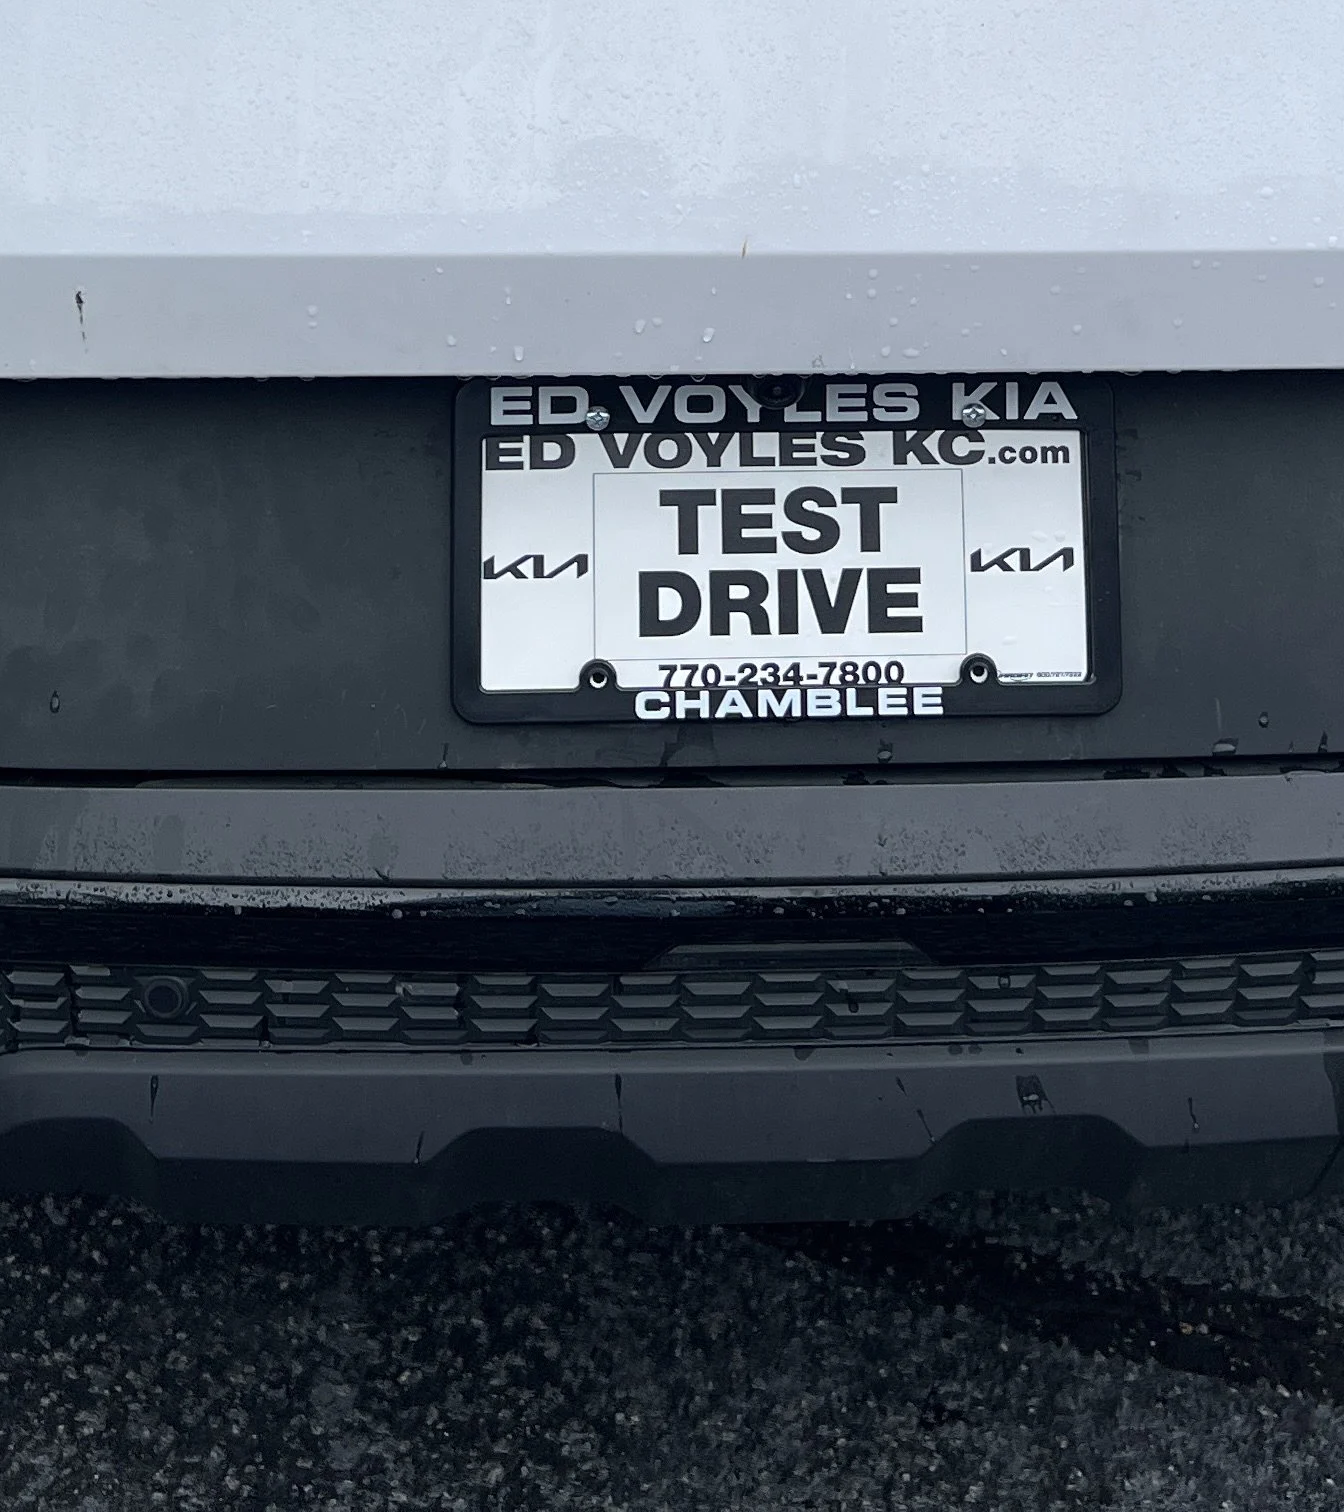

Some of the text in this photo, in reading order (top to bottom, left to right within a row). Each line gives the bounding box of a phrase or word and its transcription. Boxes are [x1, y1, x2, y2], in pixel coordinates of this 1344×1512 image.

[490, 386, 590, 425] ED
[952, 382, 1077, 421] KIA
[485, 429, 1070, 470] ED VOYLES KC.com
[659, 486, 897, 555] TEST
[483, 554, 588, 580] KIA
[969, 546, 1074, 573] KIA
[638, 567, 923, 637] DRIVE
[658, 660, 904, 688] 770-234-7800
[635, 687, 944, 720] CHAMBLEE
